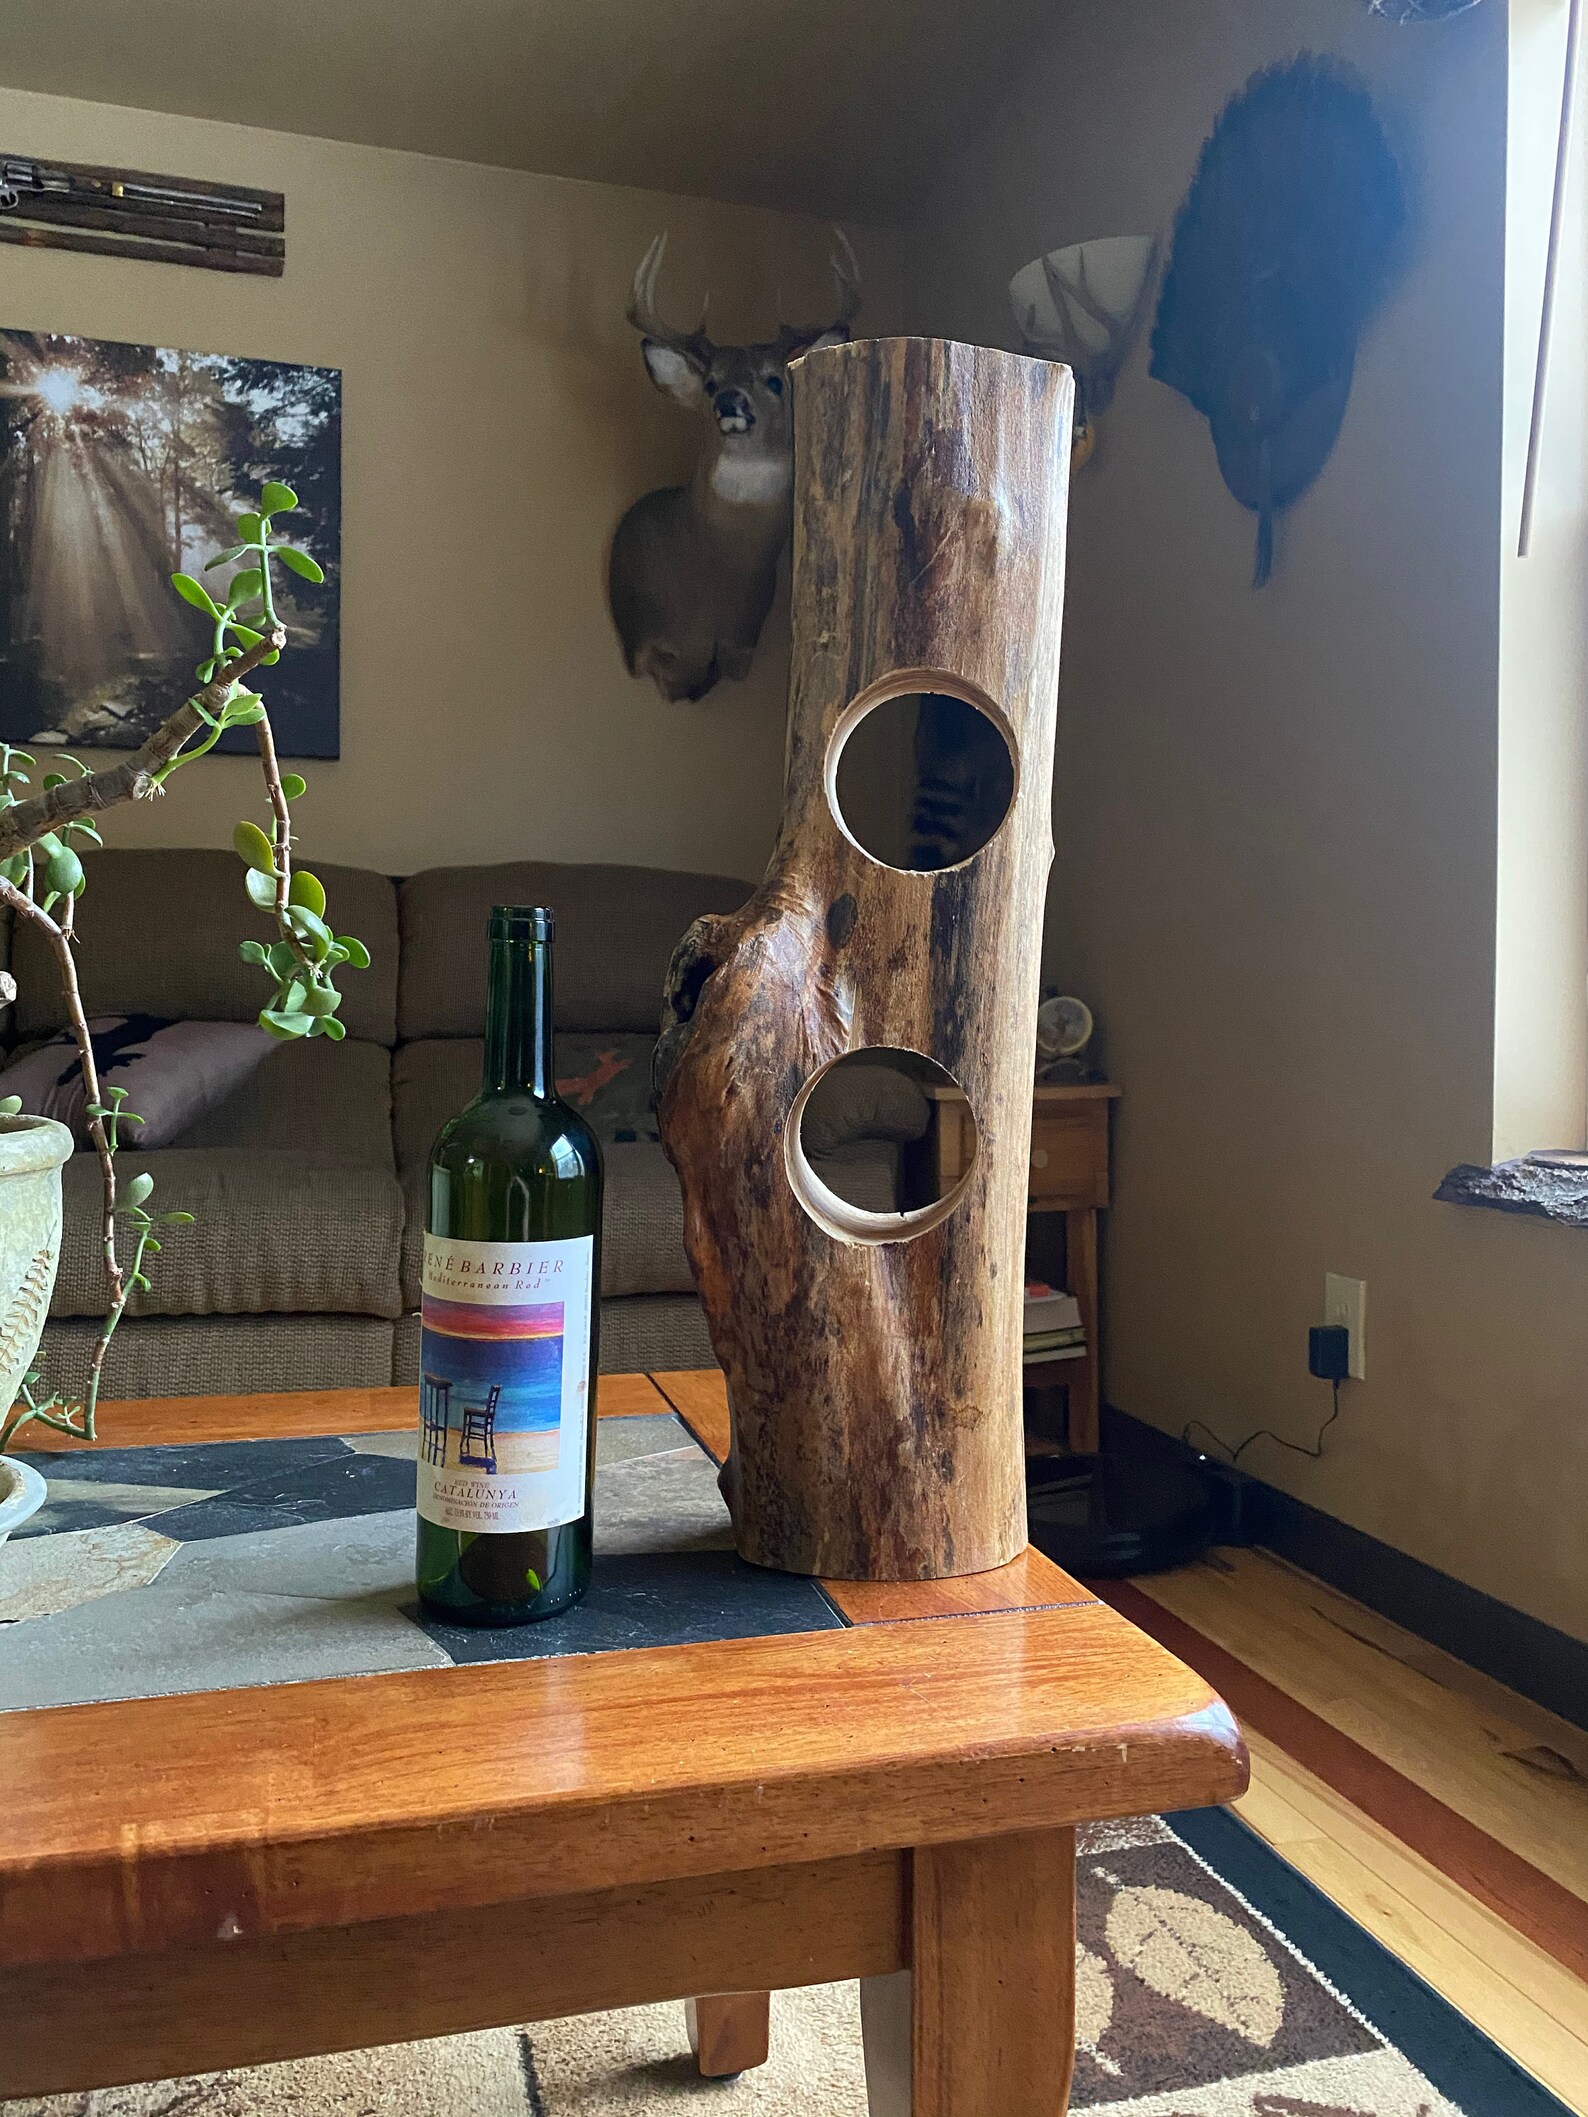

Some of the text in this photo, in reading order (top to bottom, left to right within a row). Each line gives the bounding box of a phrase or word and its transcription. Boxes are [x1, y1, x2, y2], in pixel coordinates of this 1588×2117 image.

[460, 1260, 564, 1276] BARBIER
[515, 1278, 541, 1290] Red
[434, 1481, 517, 1500] CATALUNYA
